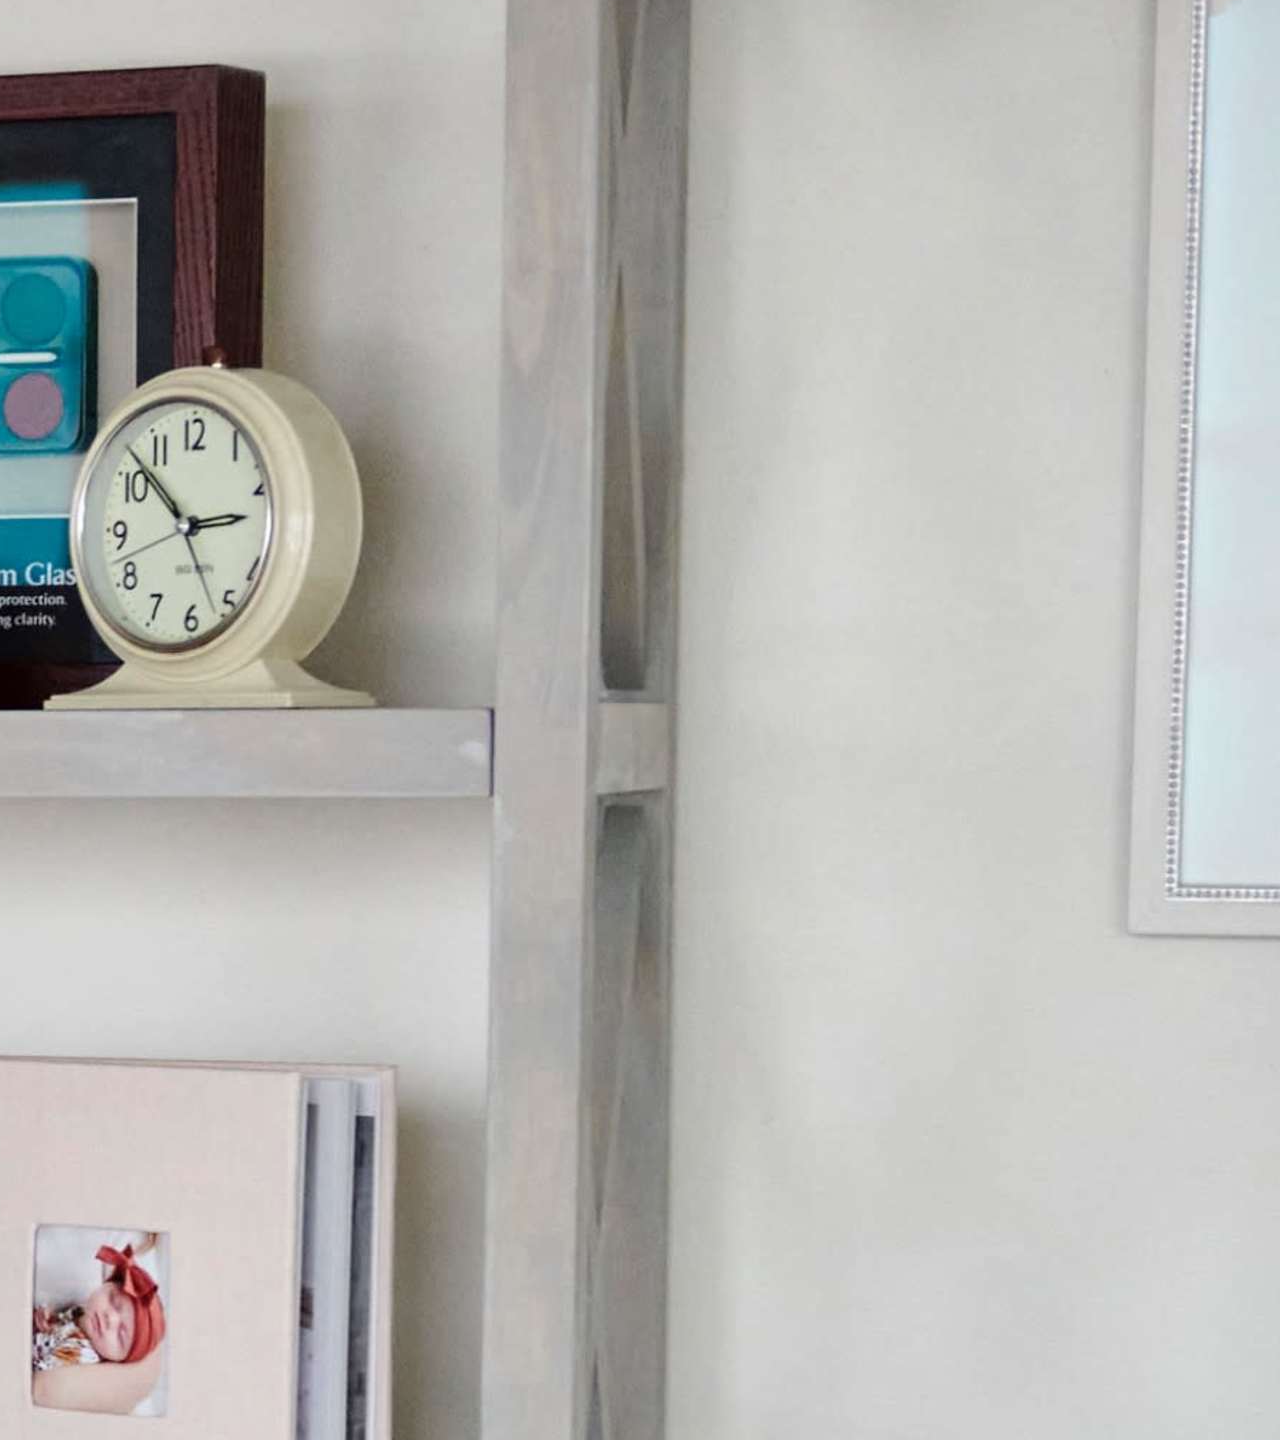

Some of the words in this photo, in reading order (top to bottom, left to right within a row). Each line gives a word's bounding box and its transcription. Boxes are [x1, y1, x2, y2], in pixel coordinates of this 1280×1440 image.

[185, 418, 205, 451] 12
[153, 434, 167, 466] 11
[125, 470, 149, 503] 10
[112, 520, 128, 551] 9
[24, 561, 78, 587] Glas
[123, 561, 138, 590] 8
[150, 593, 163, 621] 7
[184, 604, 199, 633] 6
